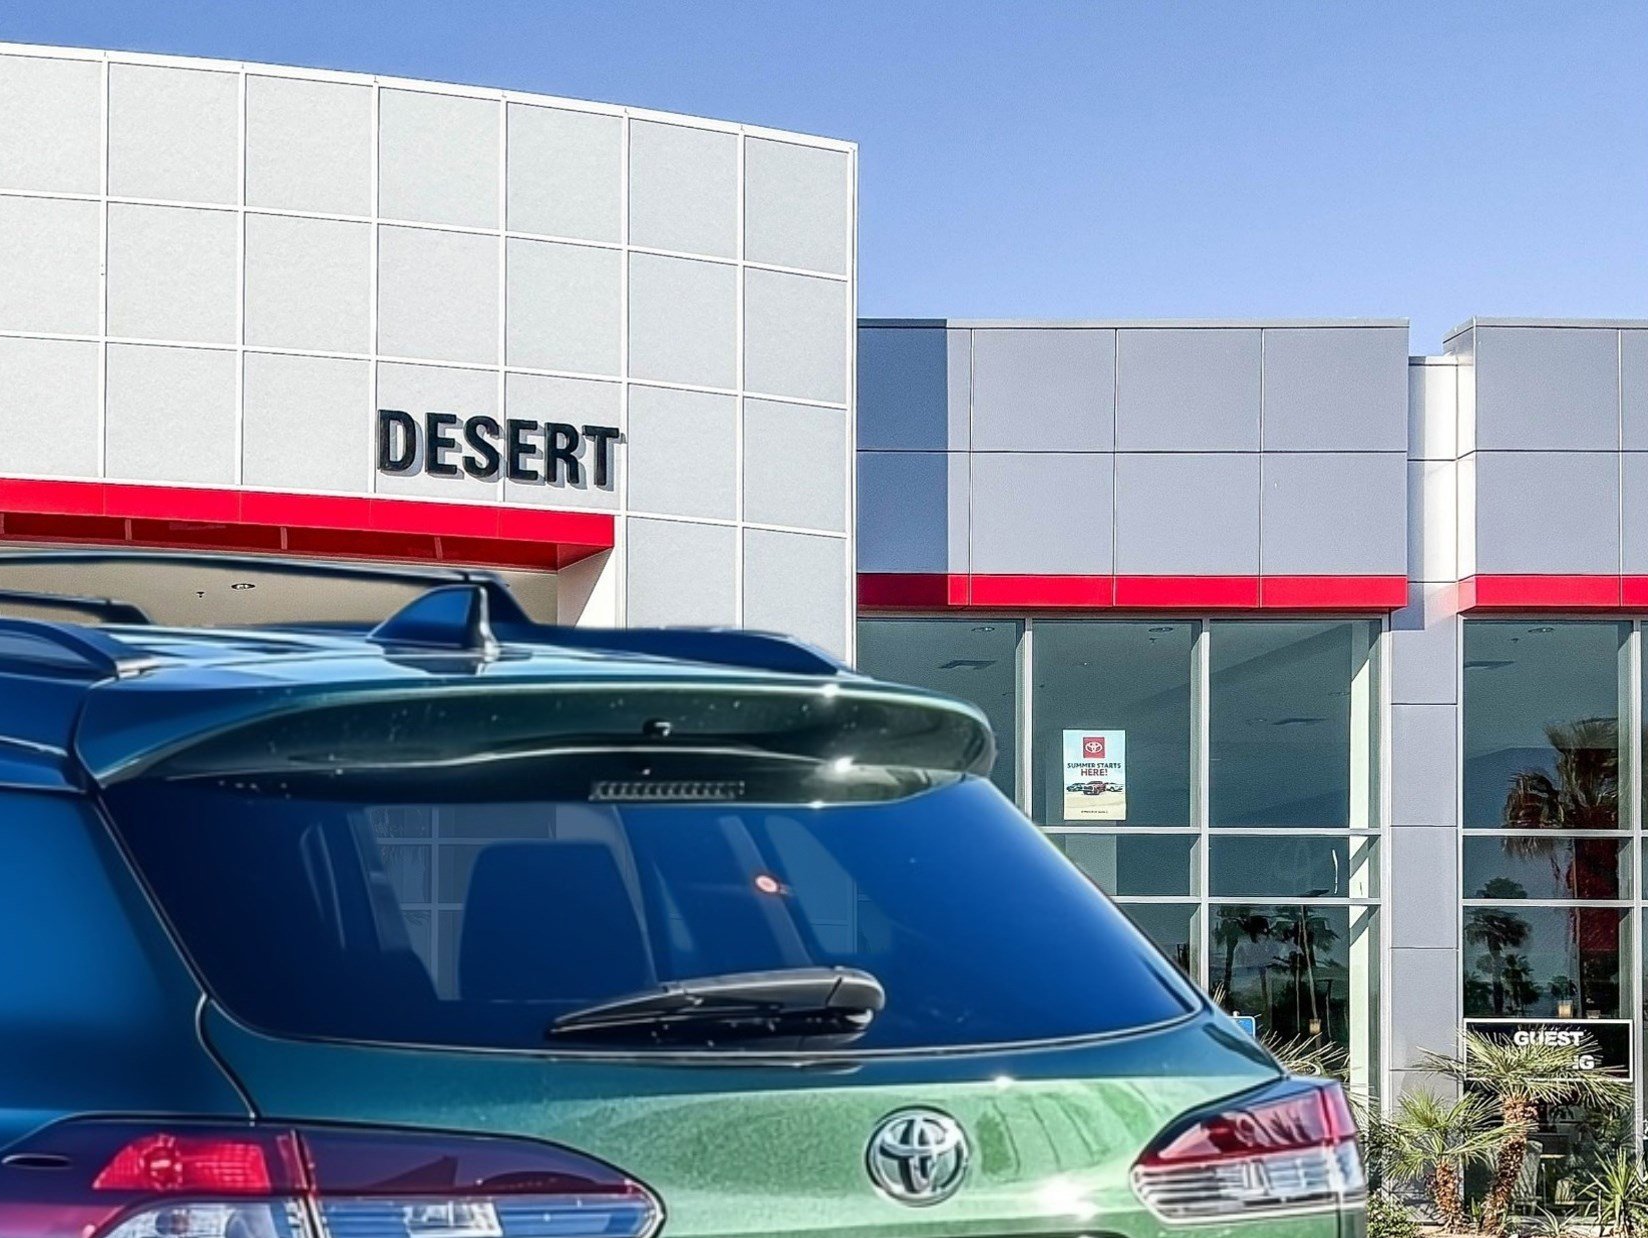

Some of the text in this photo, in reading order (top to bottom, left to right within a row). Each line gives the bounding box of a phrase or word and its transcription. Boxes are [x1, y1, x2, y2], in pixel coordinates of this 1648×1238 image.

[377, 409, 620, 486] DESERT
[1081, 768, 1108, 776] HERE!
[1513, 1030, 1584, 1047] GUEST
